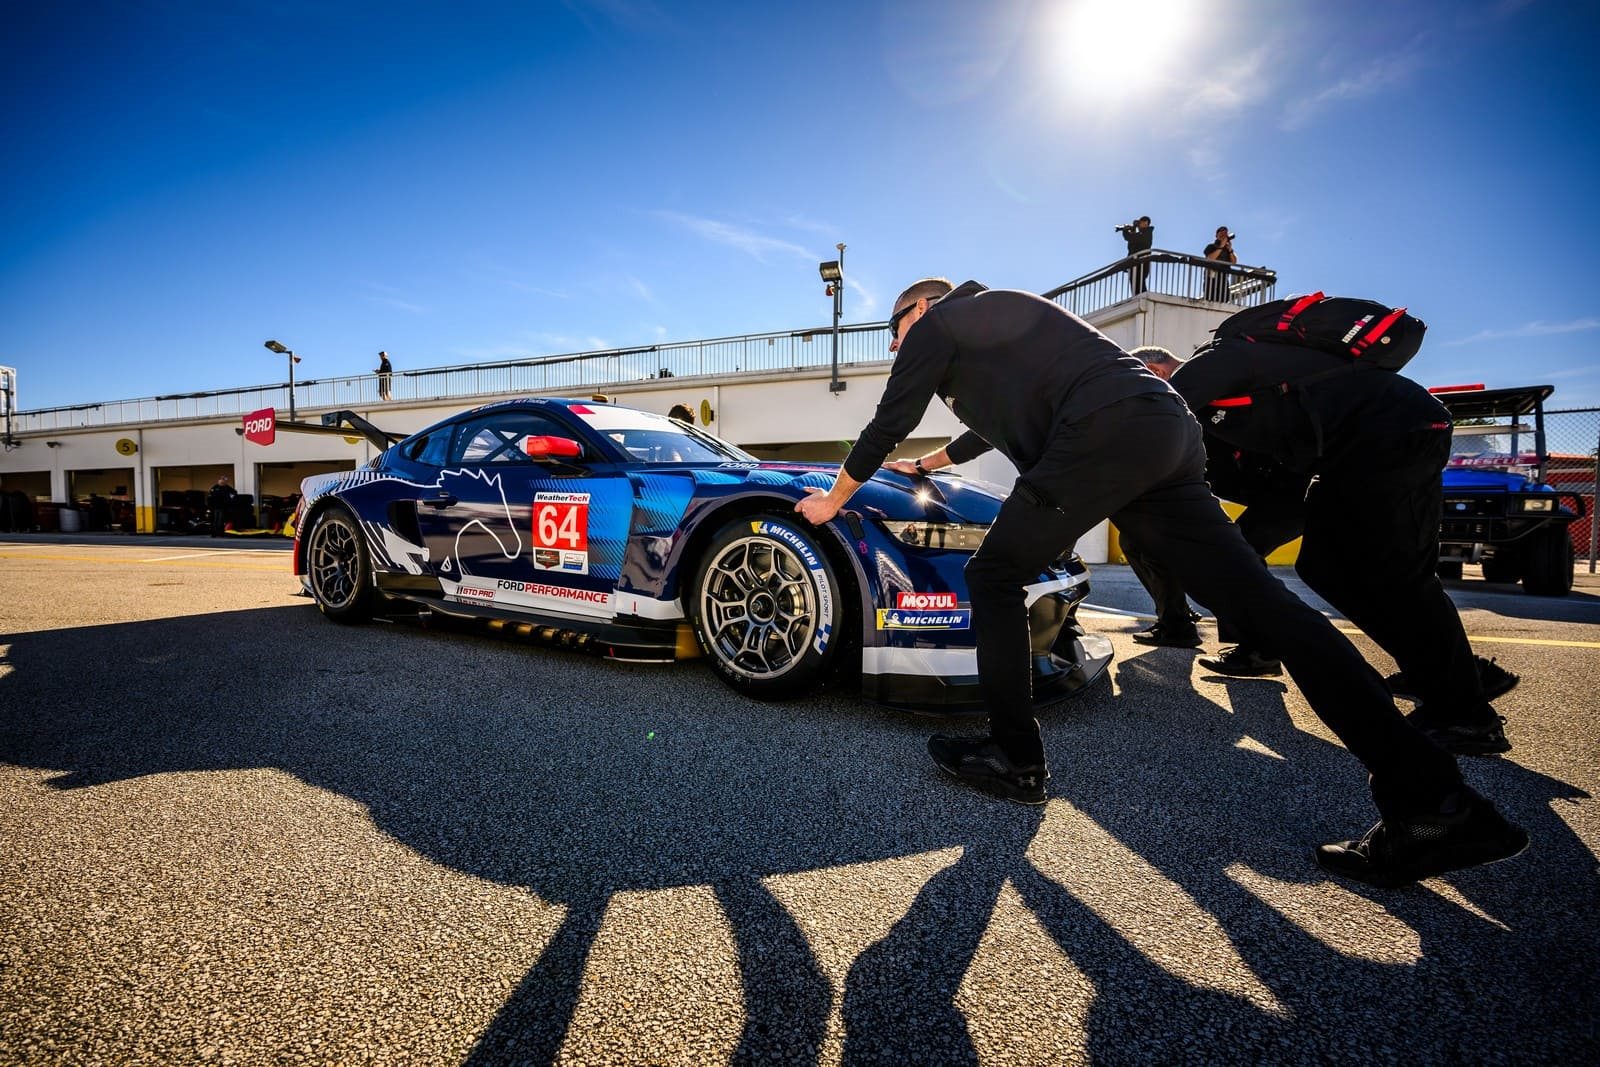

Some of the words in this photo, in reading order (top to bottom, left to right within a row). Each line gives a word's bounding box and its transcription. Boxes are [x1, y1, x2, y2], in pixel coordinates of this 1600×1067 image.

[244, 417, 272, 435] FORD
[122, 442, 130, 452] 5
[537, 494, 588, 502] WeatherTech
[538, 505, 581, 548] 64
[769, 525, 818, 568] MICHELIN
[817, 574, 828, 596] PILOT
[463, 587, 478, 596] GTD
[478, 589, 494, 598] PRO
[901, 595, 955, 608] MOTUL
[903, 616, 963, 624] MICHELIN
